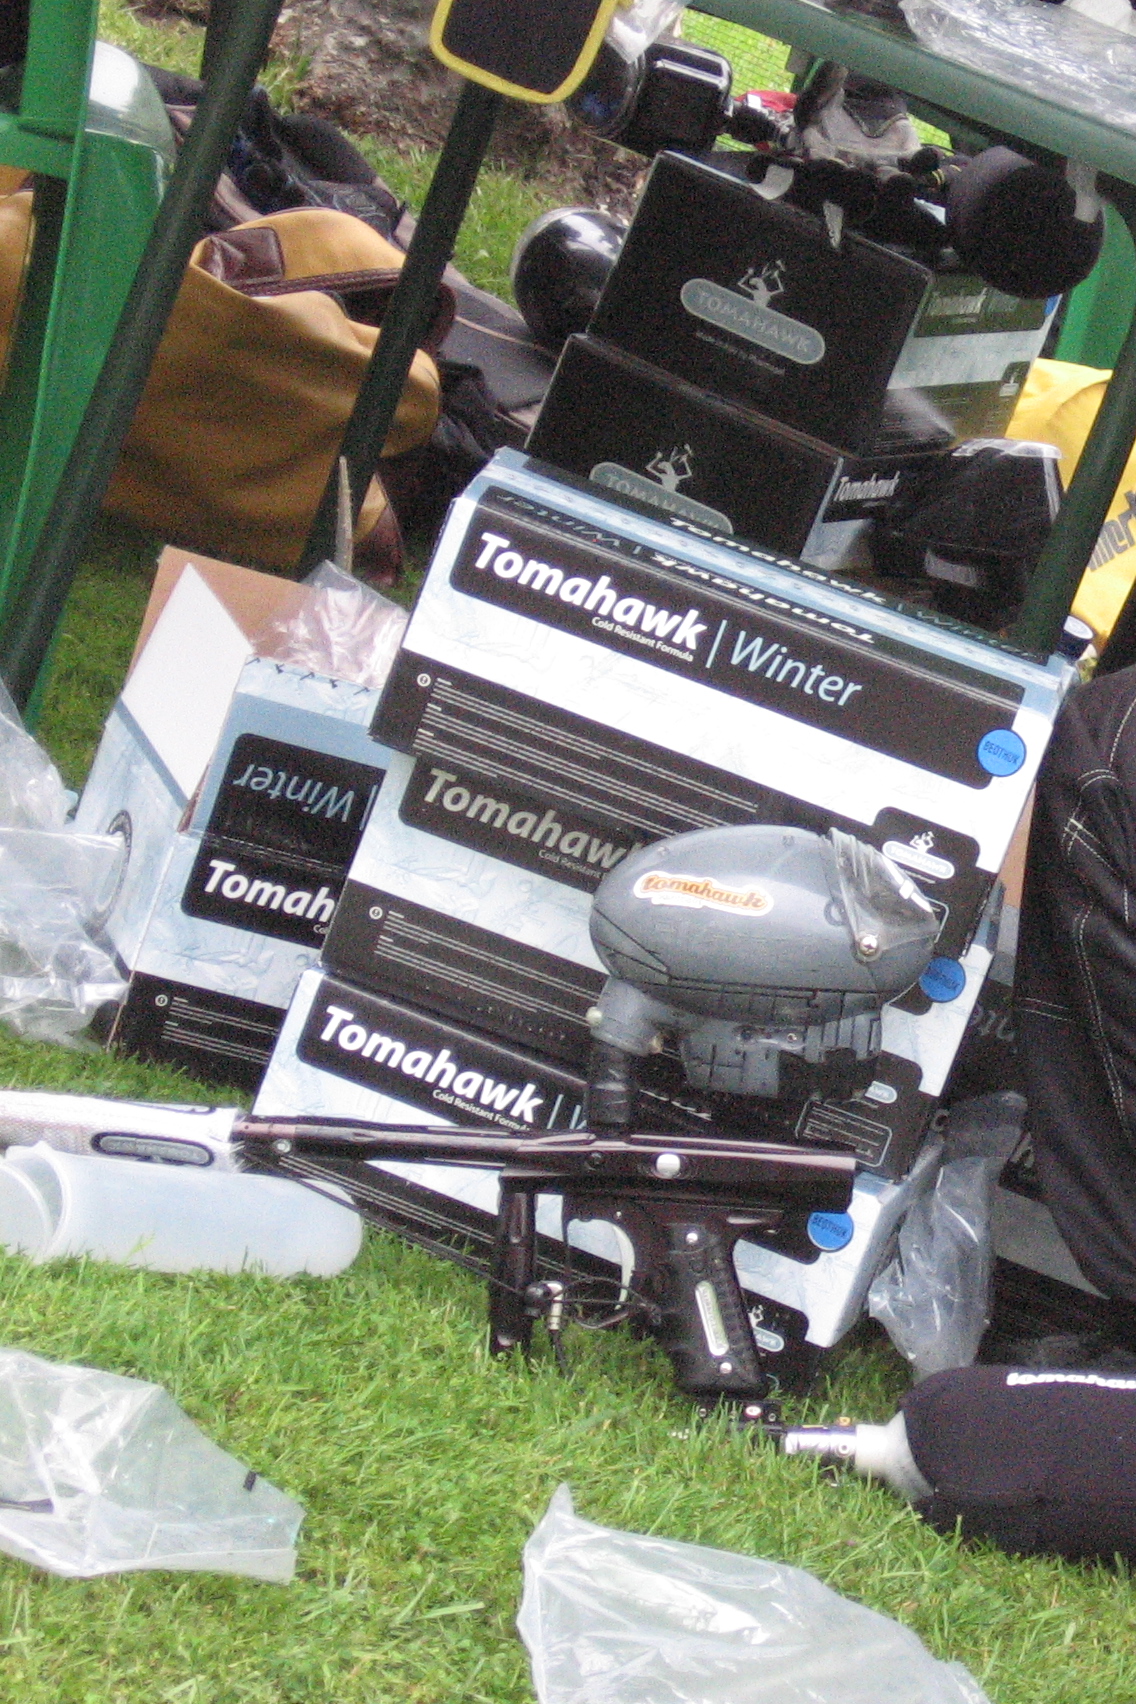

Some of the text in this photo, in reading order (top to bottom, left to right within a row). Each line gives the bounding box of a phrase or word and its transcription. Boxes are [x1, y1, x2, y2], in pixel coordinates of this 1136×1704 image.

[650, 552, 876, 645] Tomahawk
[669, 516, 887, 605] Tomahawk
[472, 532, 864, 706] Tomahawk Winter
[591, 616, 694, 662] Cold Resistant Formula
[231, 763, 356, 823] Winter
[423, 766, 645, 869] Tomahaw
[204, 858, 336, 923] Tomah
[641, 874, 768, 910] tomahawk
[320, 1004, 544, 1124] Tomahawk
[432, 1089, 454, 1104] Cold
[453, 1098, 495, 1121] Resistant
